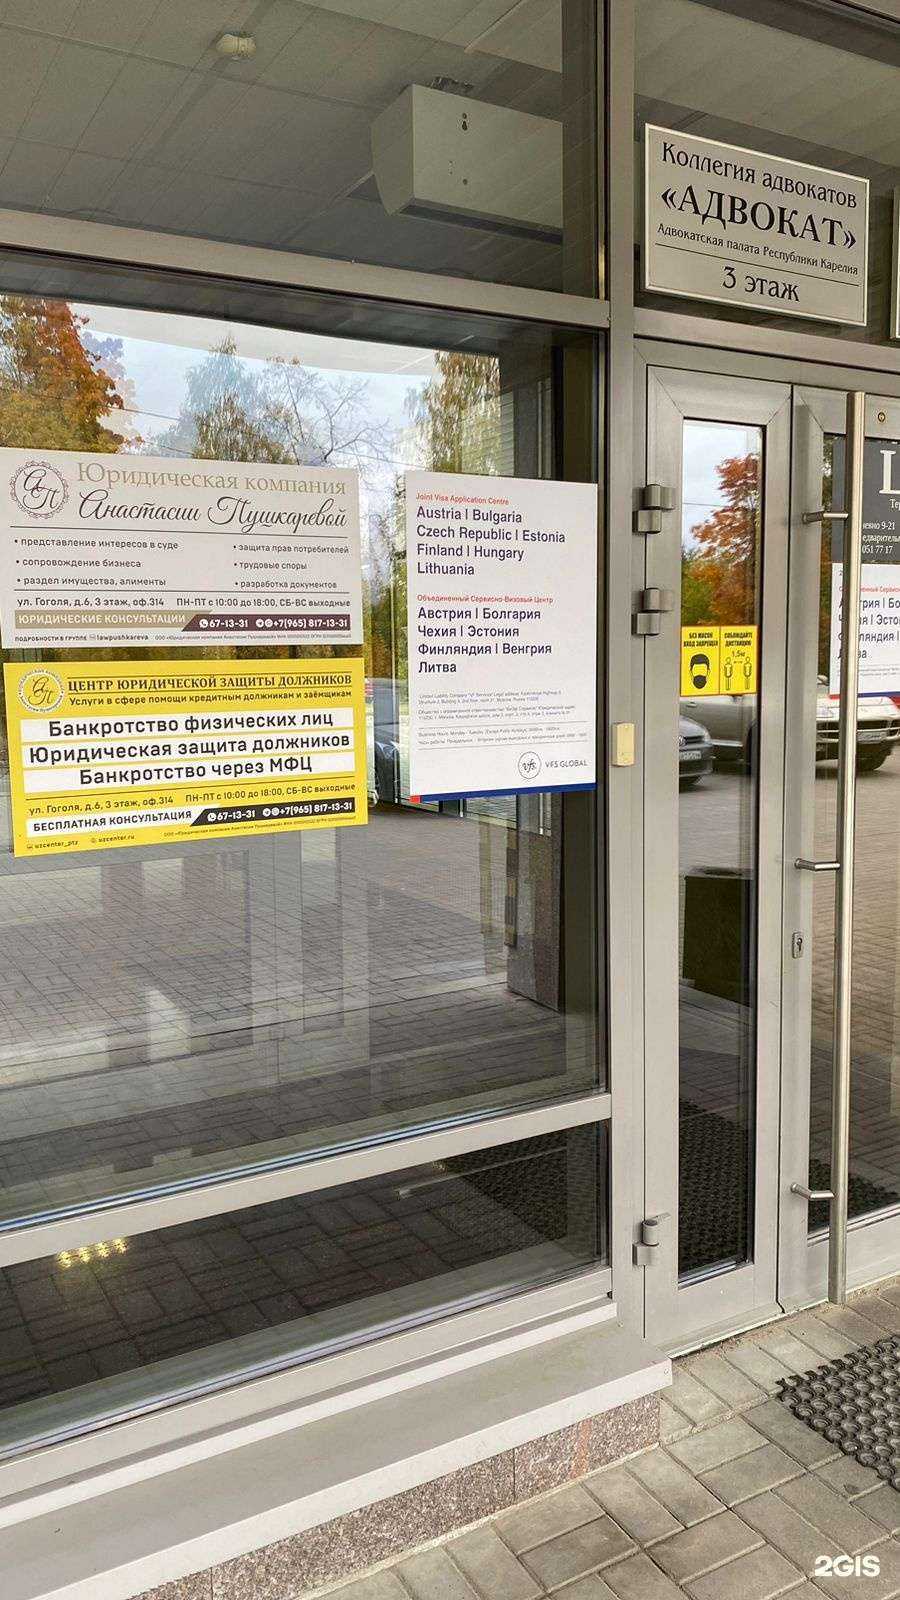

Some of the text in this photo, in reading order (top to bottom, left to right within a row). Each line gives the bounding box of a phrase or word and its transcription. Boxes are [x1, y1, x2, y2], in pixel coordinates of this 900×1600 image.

[662, 142, 857, 208] Коллегия адвокатов
[661, 184, 857, 249] «АДВОКАТ»
[657, 223, 858, 276] Адвокатская палата Республики Карелия
[722, 266, 800, 302] 3 этаж
[78, 462, 346, 495] Юридическая компания
[416, 492, 509, 505] Joint Visa Application Centre
[79, 489, 348, 533] Анастасии Пушкаревой
[417, 506, 462, 520] Austria
[472, 510, 522, 524] Bulgaria
[417, 524, 455, 538] Czech
[459, 527, 512, 542] Republic
[522, 530, 566, 543] Estonia
[21, 538, 96, 548] представление
[99, 541, 147, 550] интересов
[157, 542, 179, 550] суде
[239, 544, 349, 554] защита прав потребителей
[417, 543, 463, 557] Finland
[474, 546, 524, 562] Hungary
[22, 559, 141, 568] сопровождение бизнеса
[240, 562, 307, 571] трудовые споры
[417, 562, 475, 575] Lithuania
[24, 577, 166, 587] раздел имущества, алименты
[241, 580, 337, 590] разработка документов
[17, 598, 164, 608] ул. Гоголя, д.6, 3 этаж, оф.314
[176, 598, 206, 607] ПН-ПТ
[215, 598, 238, 607] 10:00
[240, 600, 251, 608] до
[253, 599, 278, 608] 18:00,
[280, 599, 307, 607] СБ-ВС
[308, 600, 351, 608] выходные
[18, 614, 186, 626] ЮРИДИЧЕСКИЕ КОНСУЛЬТАЦИИ
[418, 607, 472, 622] Австрия
[483, 608, 541, 621] Болгария
[209, 618, 348, 629] 67-13-31 +7(965) 817-13-31
[418, 625, 457, 637] Чехия
[467, 625, 519, 637] Эстония
[97, 634, 149, 642] lawpushkareva
[418, 644, 492, 656] Финляндия
[502, 643, 552, 656] Венгрия
[418, 662, 457, 673] Литва
[68, 679, 114, 692] ЦЕНТР
[117, 674, 217, 692] ЮРИДИЧЕСКОЙ
[220, 676, 275, 689] ЗАЩИТЫ
[278, 674, 352, 688] ДОЛЖНИКОВ
[70, 696, 104, 707] Услуги
[106, 696, 112, 705] в
[115, 695, 146, 706] сфере
[149, 694, 187, 704] помощи
[189, 693, 241, 703] кредитным
[243, 691, 294, 702] должникам
[304, 689, 352, 699] заёмщикам
[49, 713, 334, 738] Банкротство физических лиц
[29, 735, 350, 766] Юридическая защита должников
[80, 756, 312, 785] Банкротство через МФЦ
[545, 759, 588, 768] VFS GLOBAL
[185, 793, 215, 802] ПН-ПТ
[223, 790, 246, 800] 10:00
[247, 791, 259, 799] до
[261, 788, 285, 798] 18:00,
[287, 785, 313, 795] СБ-ВС
[315, 783, 356, 793] выходные
[29, 796, 174, 816] ул. Гоголя, д.6, 3 этаж, оф.314
[216, 802, 352, 821] 67-13-31 +7(965) 817-13-31
[34, 810, 192, 832] БЕСПЛАТНАЯ КОНСУЛЬТАЦИЯ
